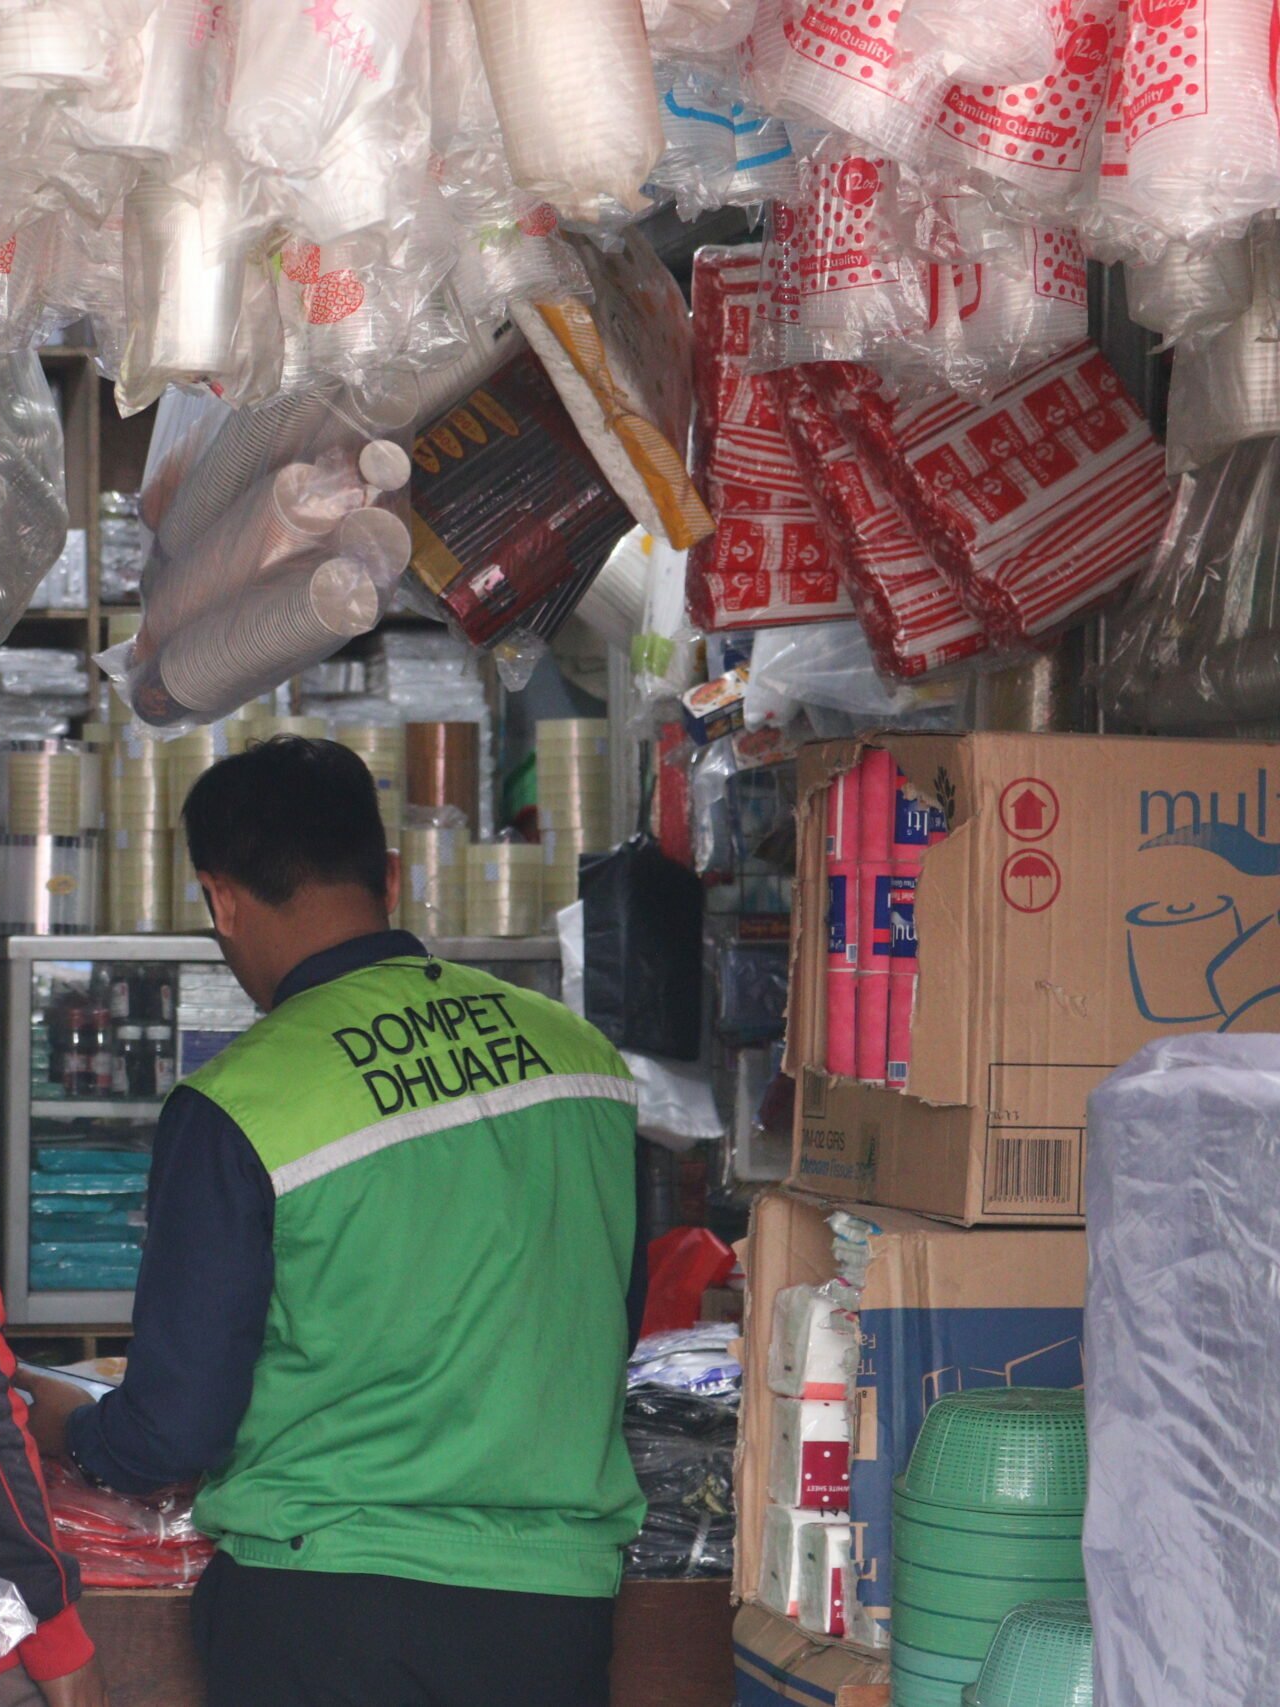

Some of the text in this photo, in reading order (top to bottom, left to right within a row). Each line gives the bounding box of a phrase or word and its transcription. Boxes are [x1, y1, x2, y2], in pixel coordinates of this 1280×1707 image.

[839, 29, 894, 63] Quality
[1004, 118, 1060, 144] Quality
[1140, 768, 1280, 838] mul
[332, 993, 517, 1068] DOMPET
[362, 1034, 554, 1116] DHUAFA
